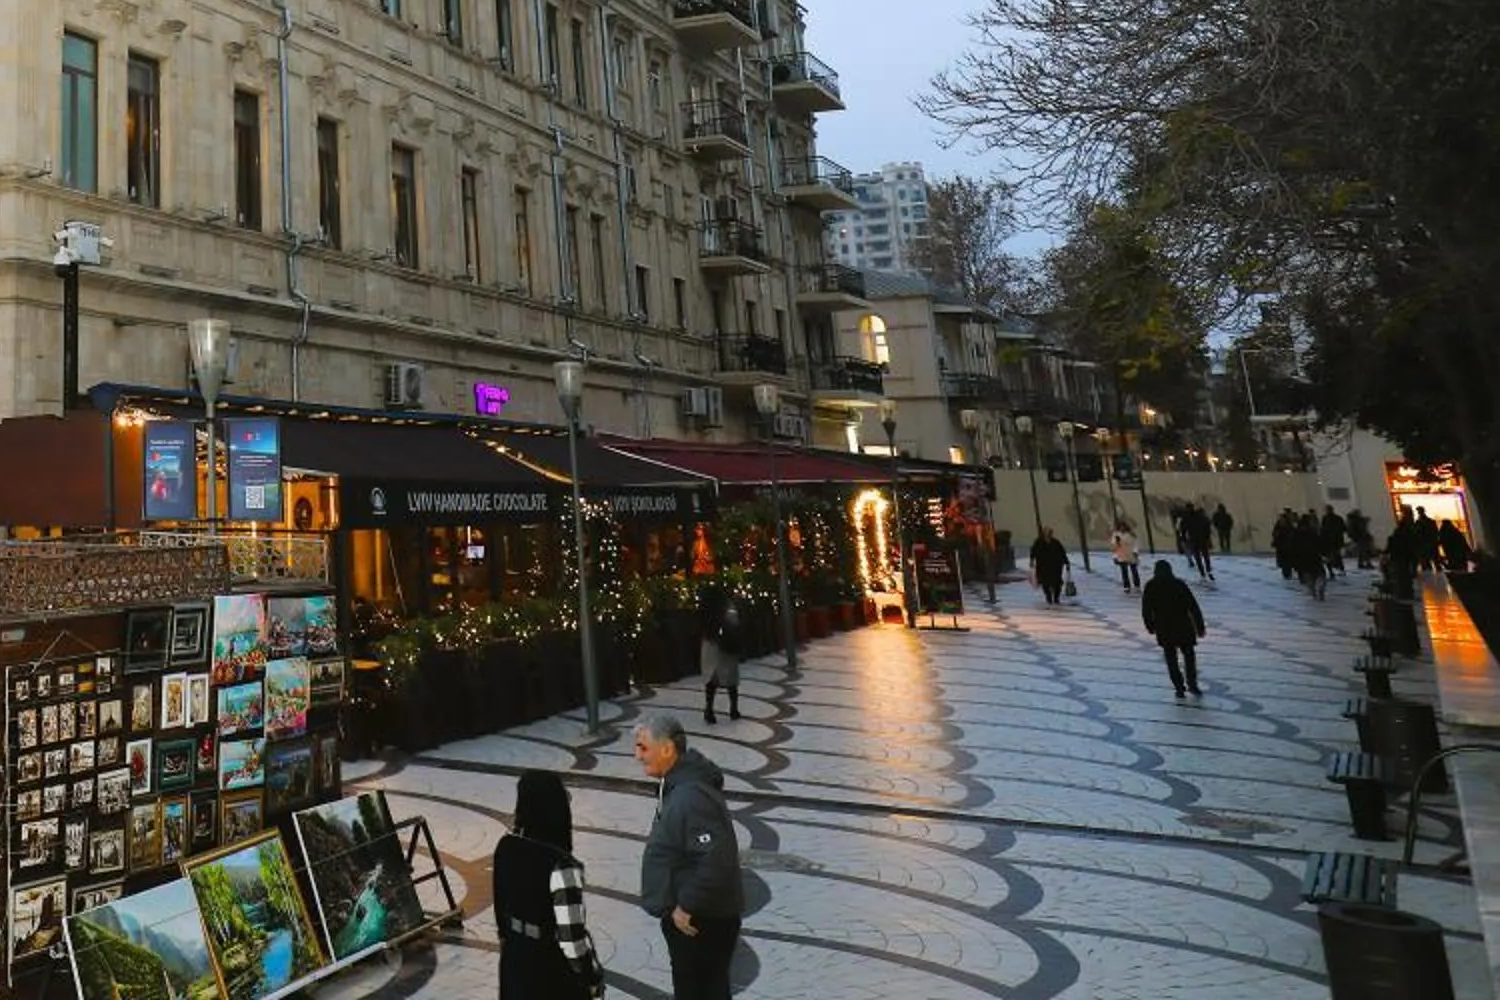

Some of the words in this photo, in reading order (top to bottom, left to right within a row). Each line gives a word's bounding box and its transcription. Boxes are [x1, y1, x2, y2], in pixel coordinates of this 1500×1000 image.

[407, 491, 433, 512] LVIV
[434, 491, 492, 512] HANDMADE
[493, 492, 549, 512] CHOCOLATE
